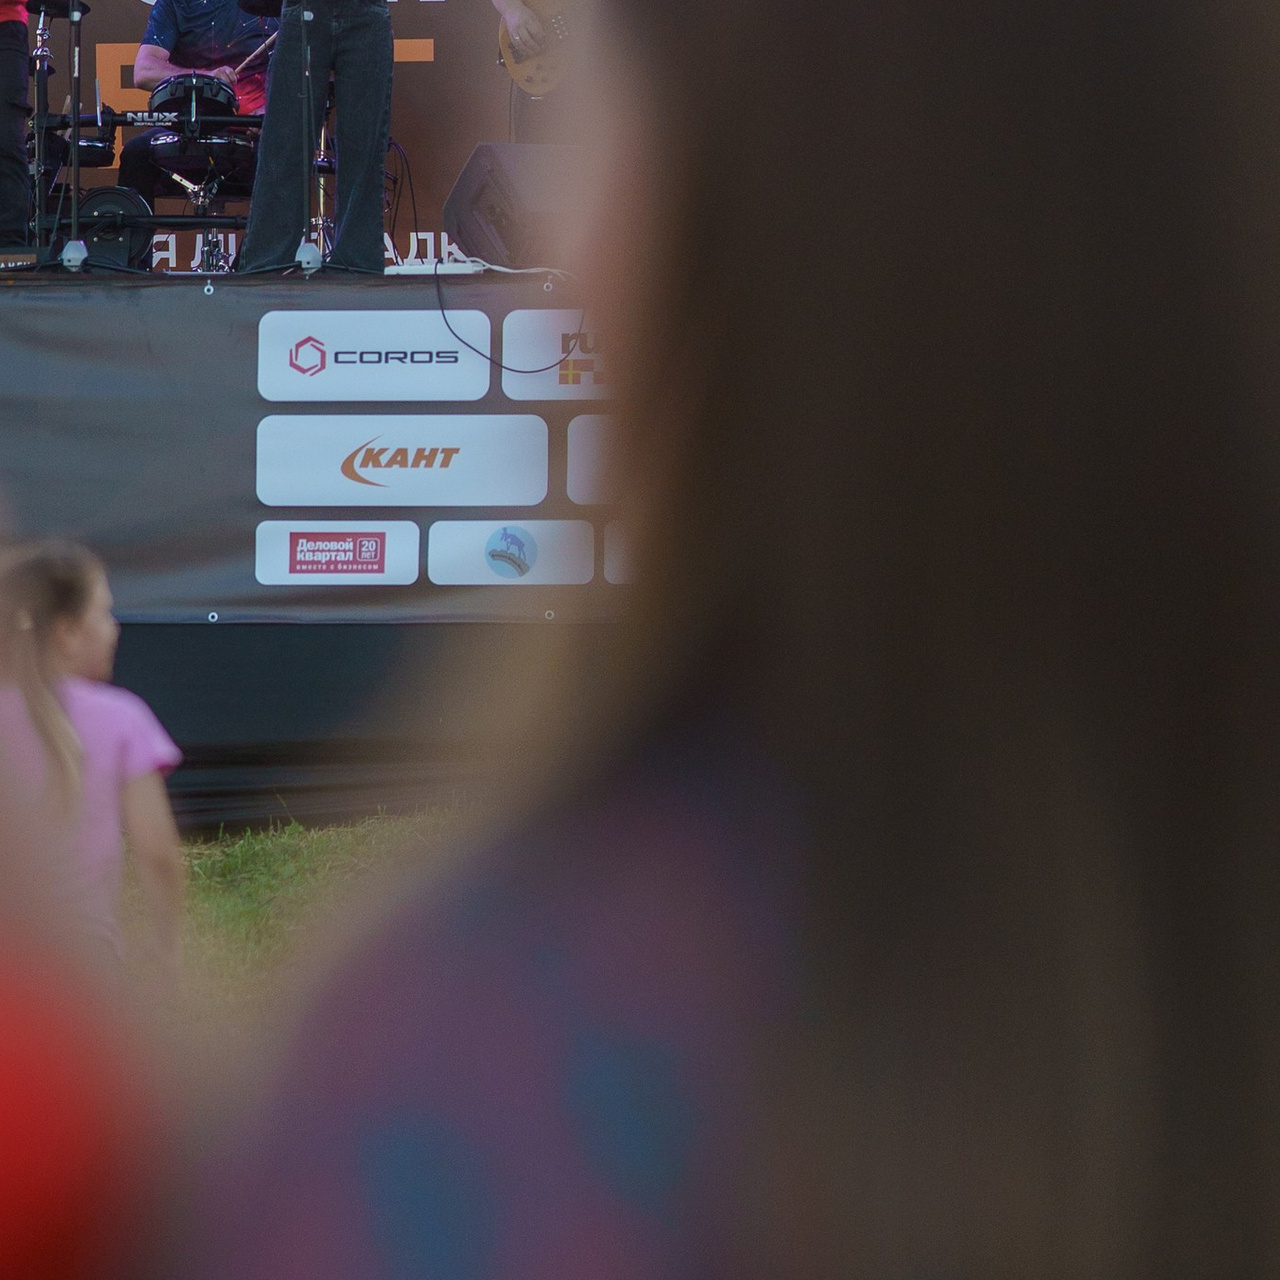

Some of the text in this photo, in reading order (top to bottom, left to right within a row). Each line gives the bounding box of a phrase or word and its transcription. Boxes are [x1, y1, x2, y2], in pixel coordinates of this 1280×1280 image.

[126, 112, 179, 122] NUX
[334, 350, 459, 365] COROS
[359, 447, 461, 469] КАНТ
[296, 538, 354, 552] Деловой
[361, 540, 376, 552] 20
[296, 551, 354, 563] квартал
[361, 551, 376, 559] лет
